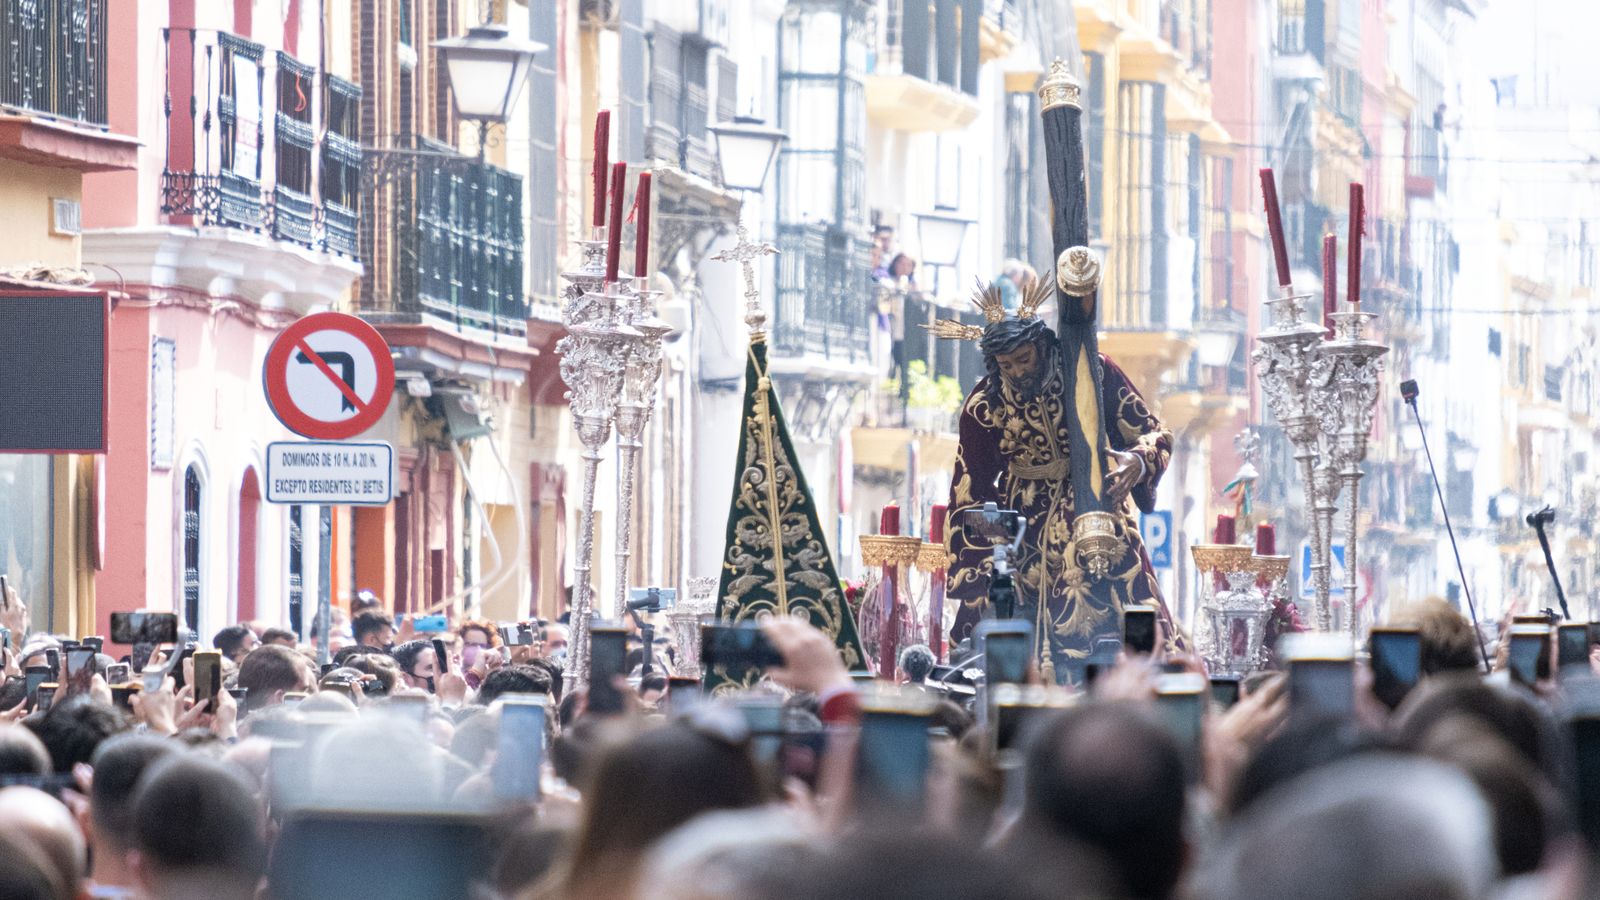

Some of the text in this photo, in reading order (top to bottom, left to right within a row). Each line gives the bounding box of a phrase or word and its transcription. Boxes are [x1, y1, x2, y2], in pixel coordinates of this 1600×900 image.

[282, 453, 319, 467] DOMINGOS
[322, 453, 331, 467] DE
[334, 452, 341, 467] 10
[352, 453, 357, 467] A
[359, 453, 367, 467] 20
[275, 480, 306, 494] EXCEPTO
[309, 480, 352, 494] RESIDENTES
[363, 480, 384, 494] BETIS
[1144, 515, 1167, 560] P
